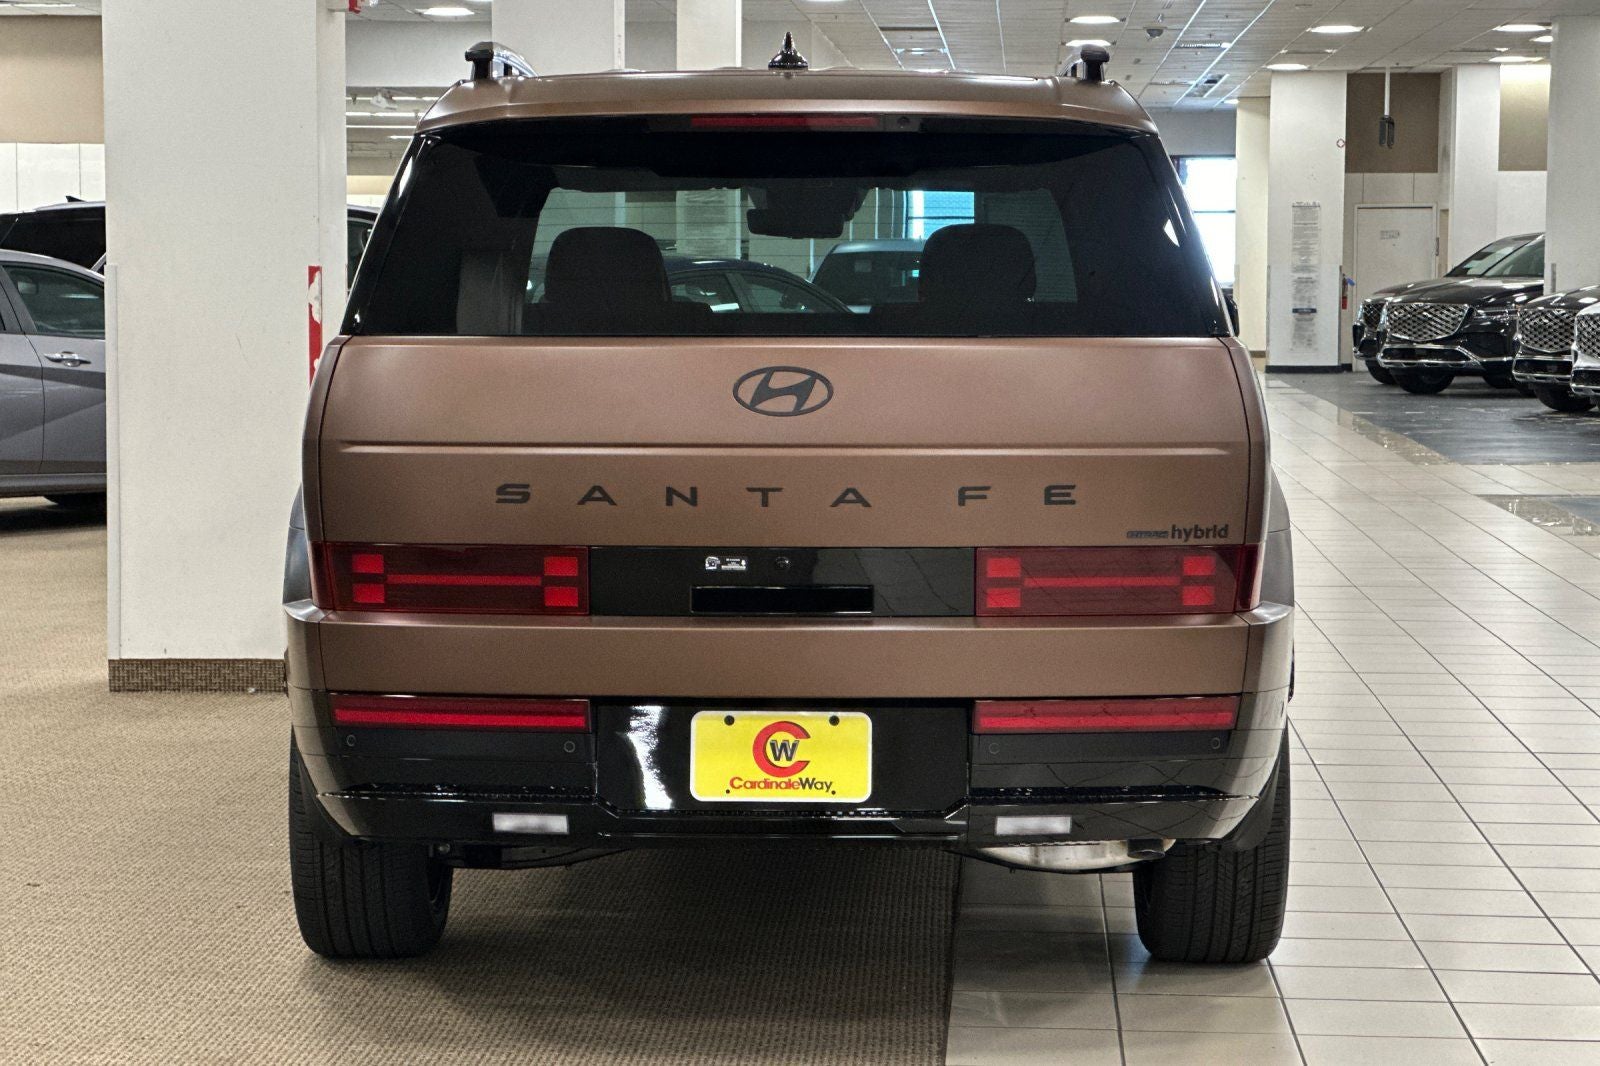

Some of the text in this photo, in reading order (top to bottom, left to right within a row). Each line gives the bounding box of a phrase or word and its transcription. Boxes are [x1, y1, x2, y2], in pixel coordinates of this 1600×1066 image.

[495, 483, 1077, 508] SANTA FE
[1171, 524, 1229, 541] hybrid
[729, 776, 833, 793] CardinaleWay
